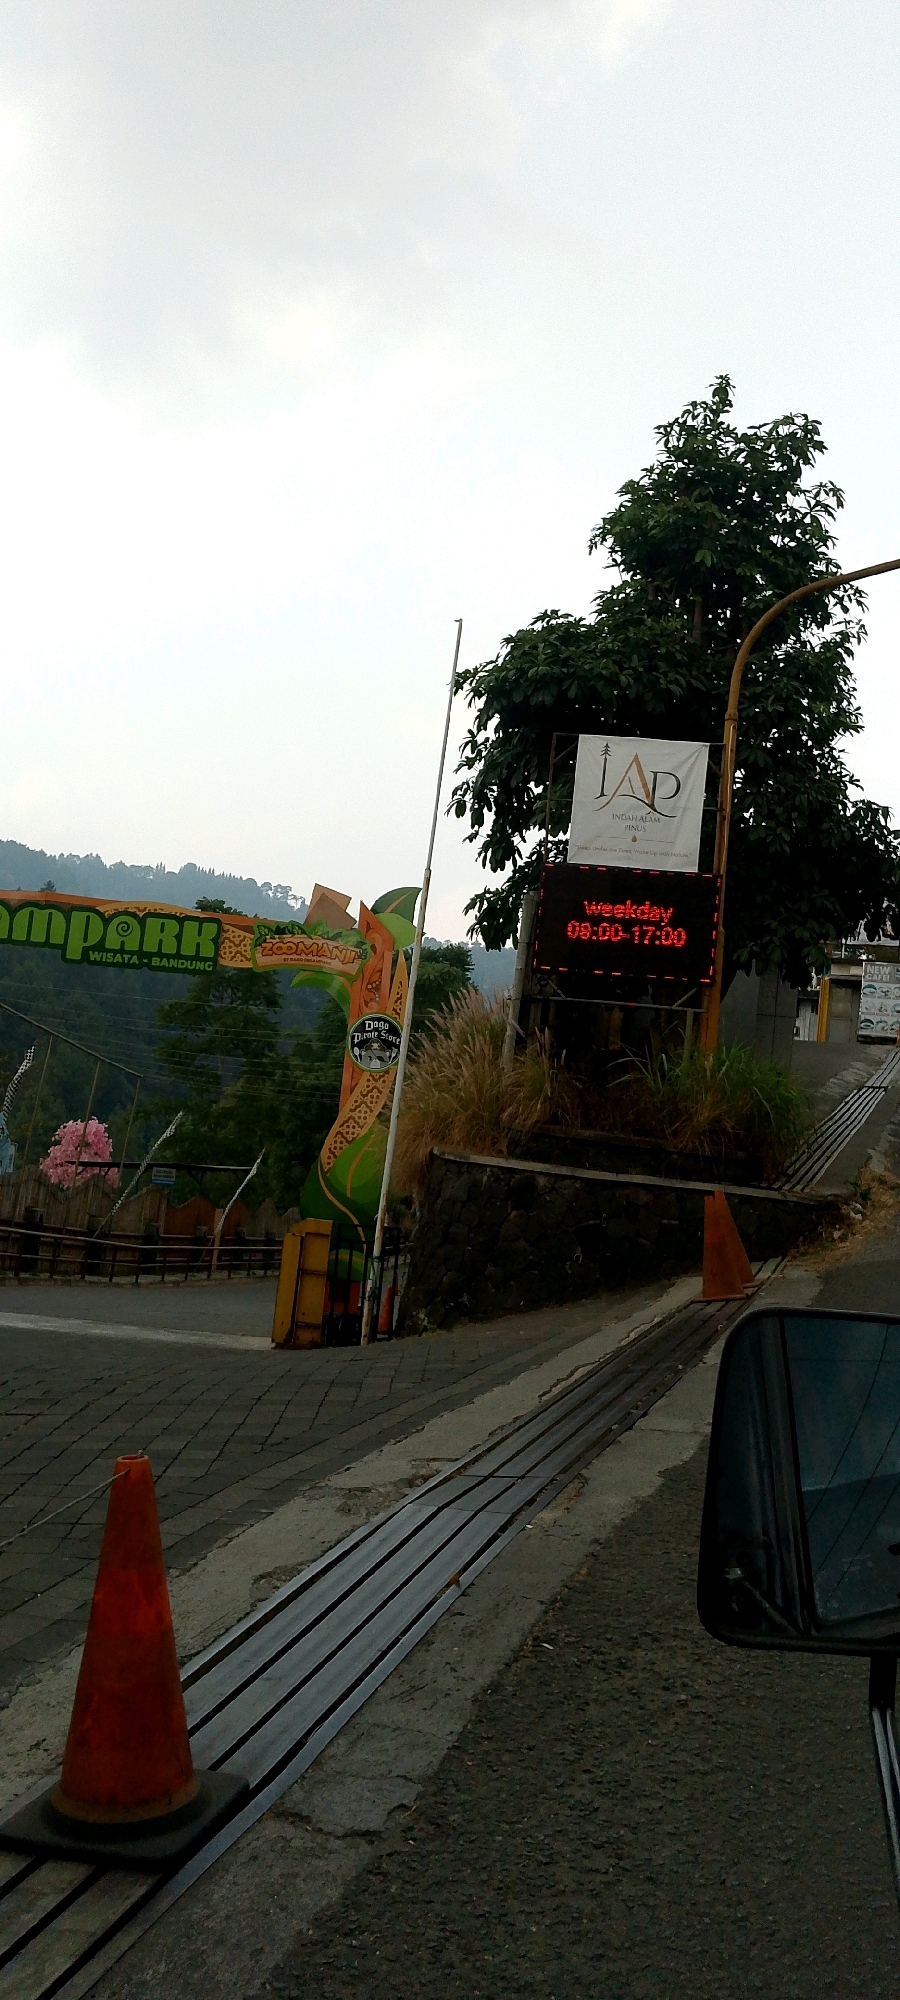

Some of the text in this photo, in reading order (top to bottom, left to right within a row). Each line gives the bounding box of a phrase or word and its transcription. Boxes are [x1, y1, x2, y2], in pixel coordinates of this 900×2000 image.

[612, 813, 661, 824] INDAH ALAM
[583, 899, 673, 924] weekday
[89, 951, 139, 965] WISATA
[151, 957, 213, 971] BANDUNG
[866, 964, 890, 974] NEW
[365, 1020, 389, 1031] Dago
[352, 1030, 400, 1044] Pirate Store
